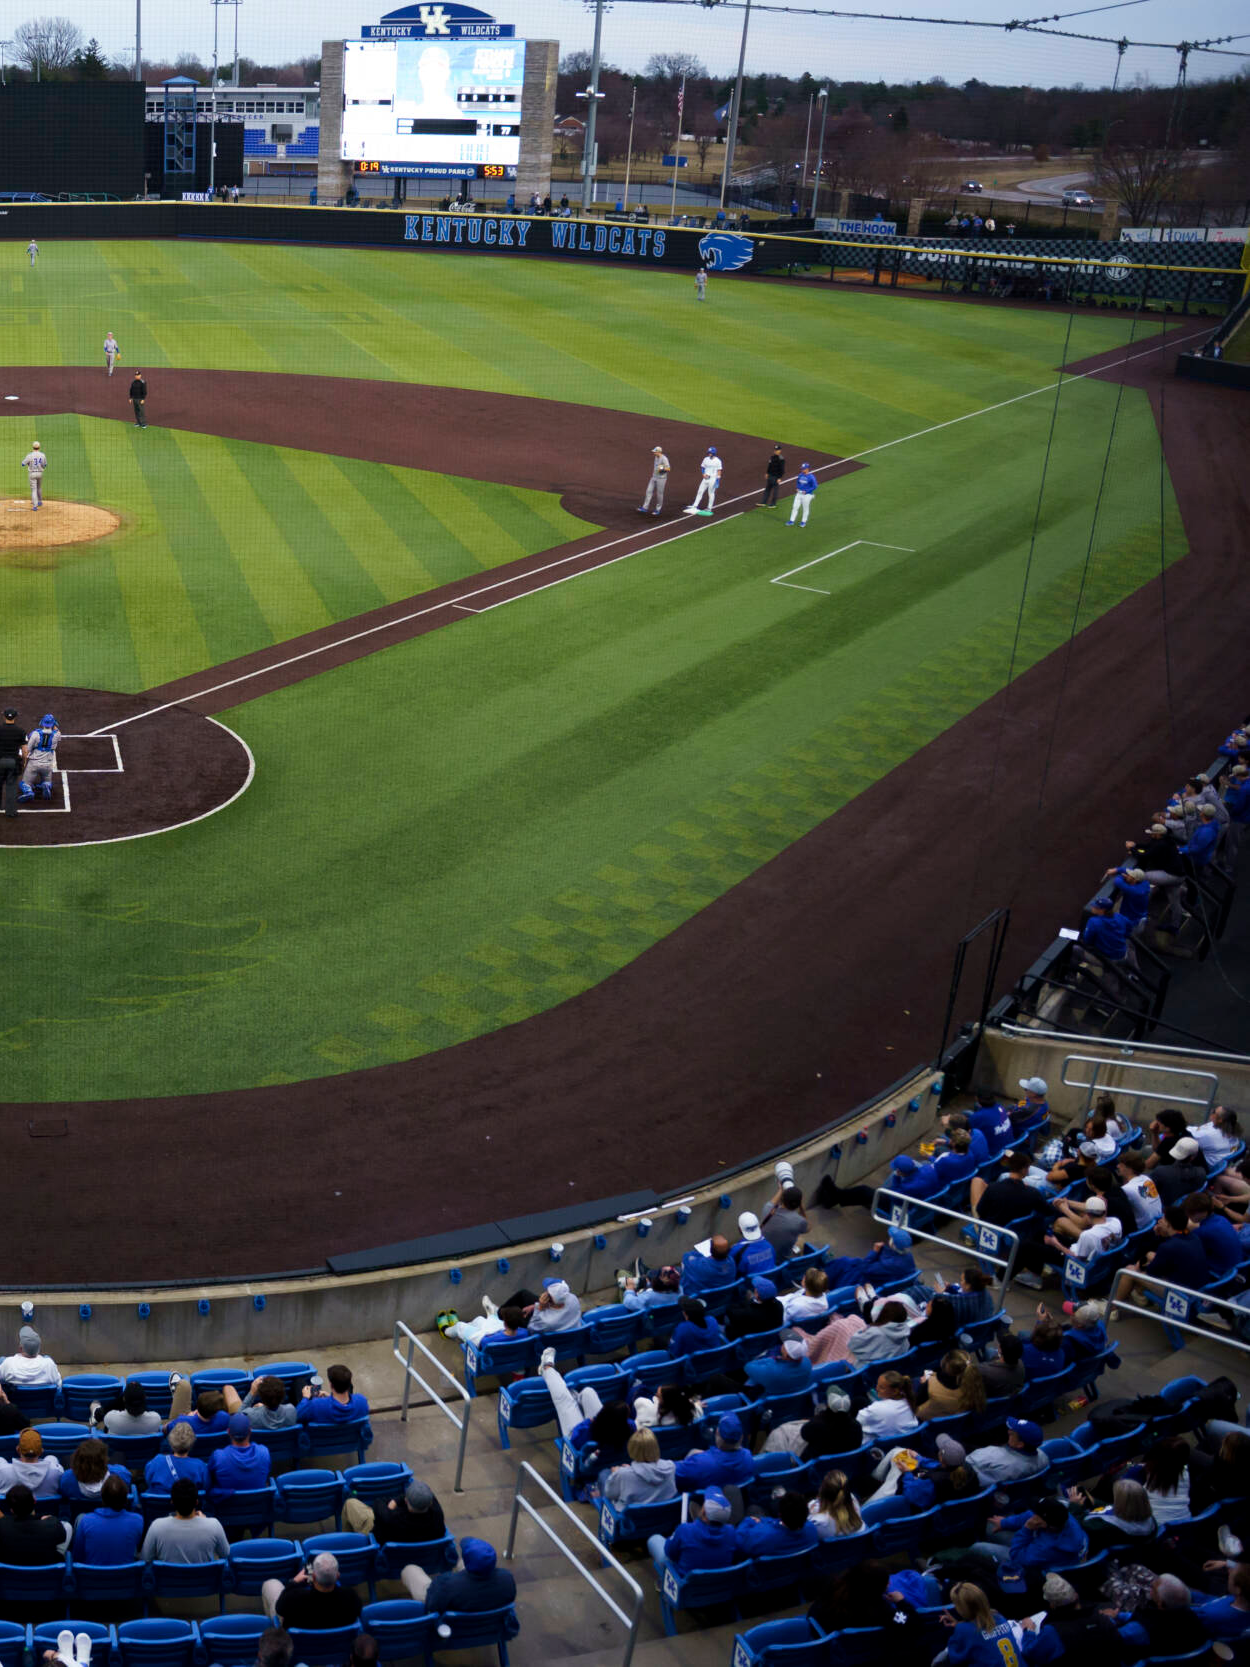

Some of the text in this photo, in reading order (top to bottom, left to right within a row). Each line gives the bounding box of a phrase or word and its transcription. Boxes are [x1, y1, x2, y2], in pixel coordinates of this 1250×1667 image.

[419, 6, 451, 34] UK
[370, 26, 500, 36] KENTUCKY WILDCATS
[360, 161, 379, 171] 0:19
[484, 166, 504, 176] 5:53
[840, 222, 862, 232] THE
[863, 223, 895, 234] HOOK
[404, 215, 666, 258] KENTUCKY WILDCATS
[33, 457, 43, 466] 34
[997, 1638, 1018, 1667] 8
